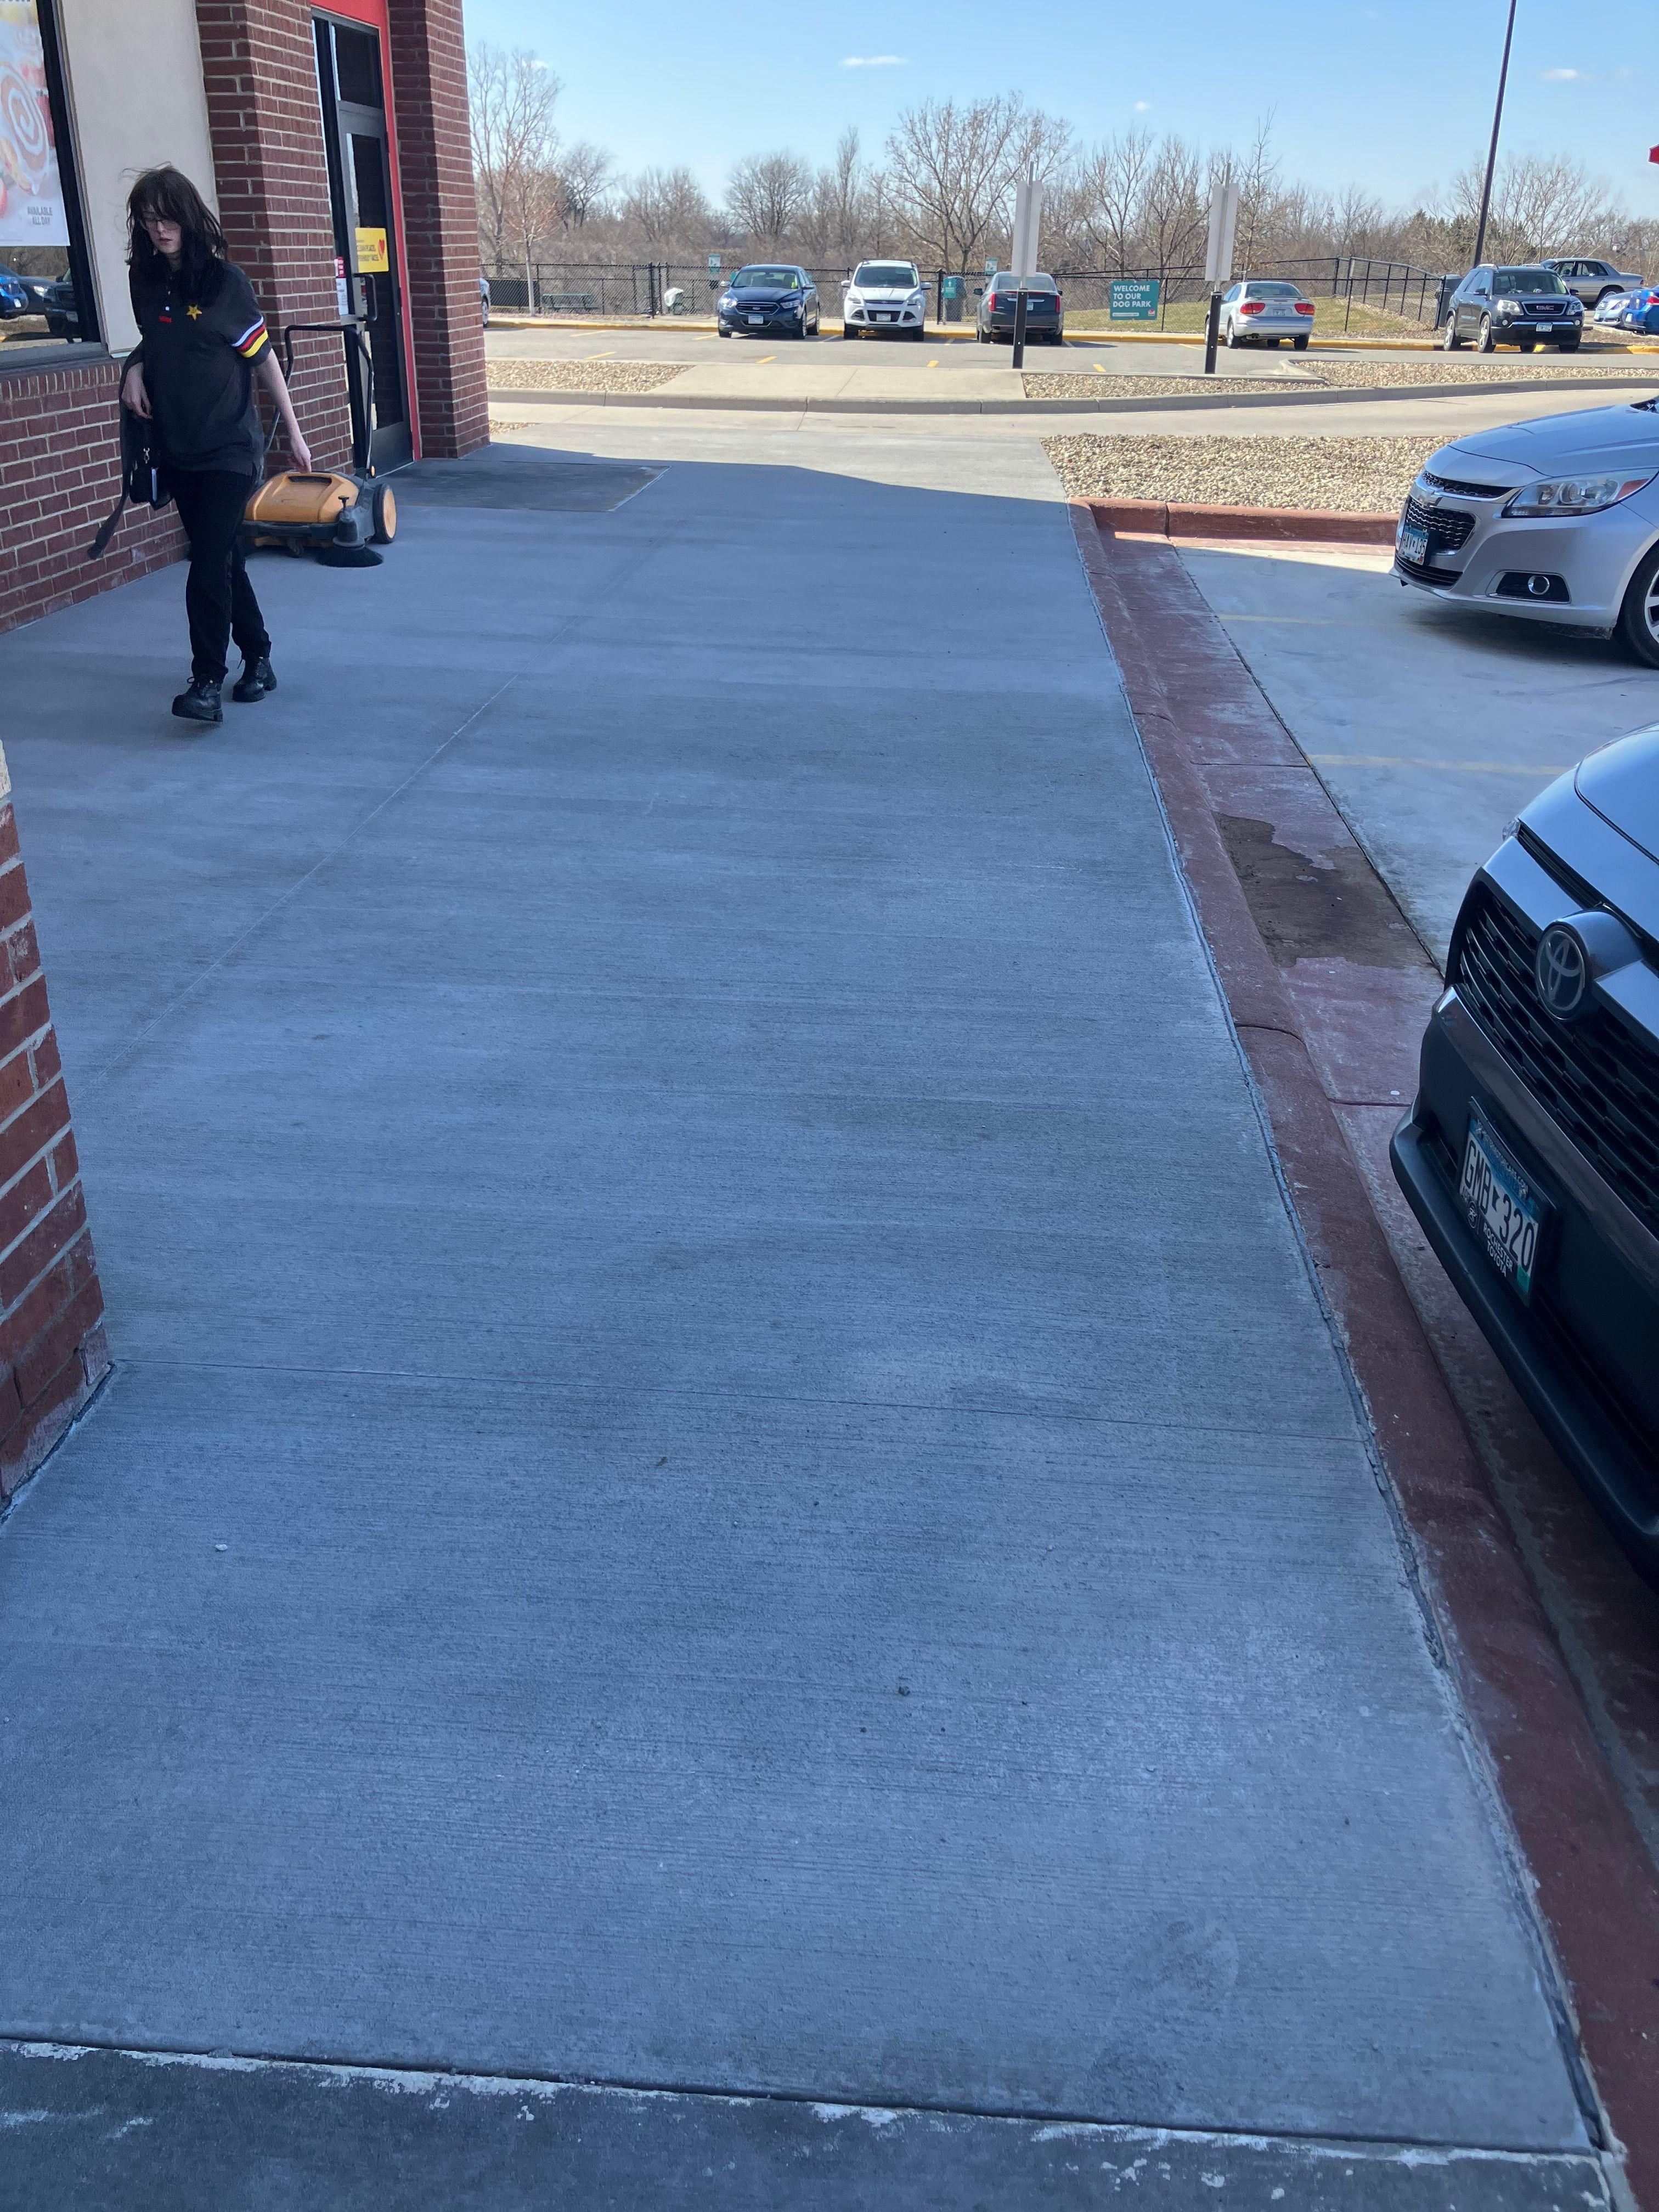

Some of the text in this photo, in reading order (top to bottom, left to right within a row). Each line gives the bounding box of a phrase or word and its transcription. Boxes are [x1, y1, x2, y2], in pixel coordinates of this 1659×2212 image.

[27, 206, 53, 216] AVAILABLE
[32, 216, 50, 225] ALL DAY
[1464, 1139, 1492, 1215] GMB
[1499, 1193, 1534, 1272] 320
[1483, 1222, 1513, 1273] ROCHESTER
[1487, 1240, 1506, 1277] TOYOTA
